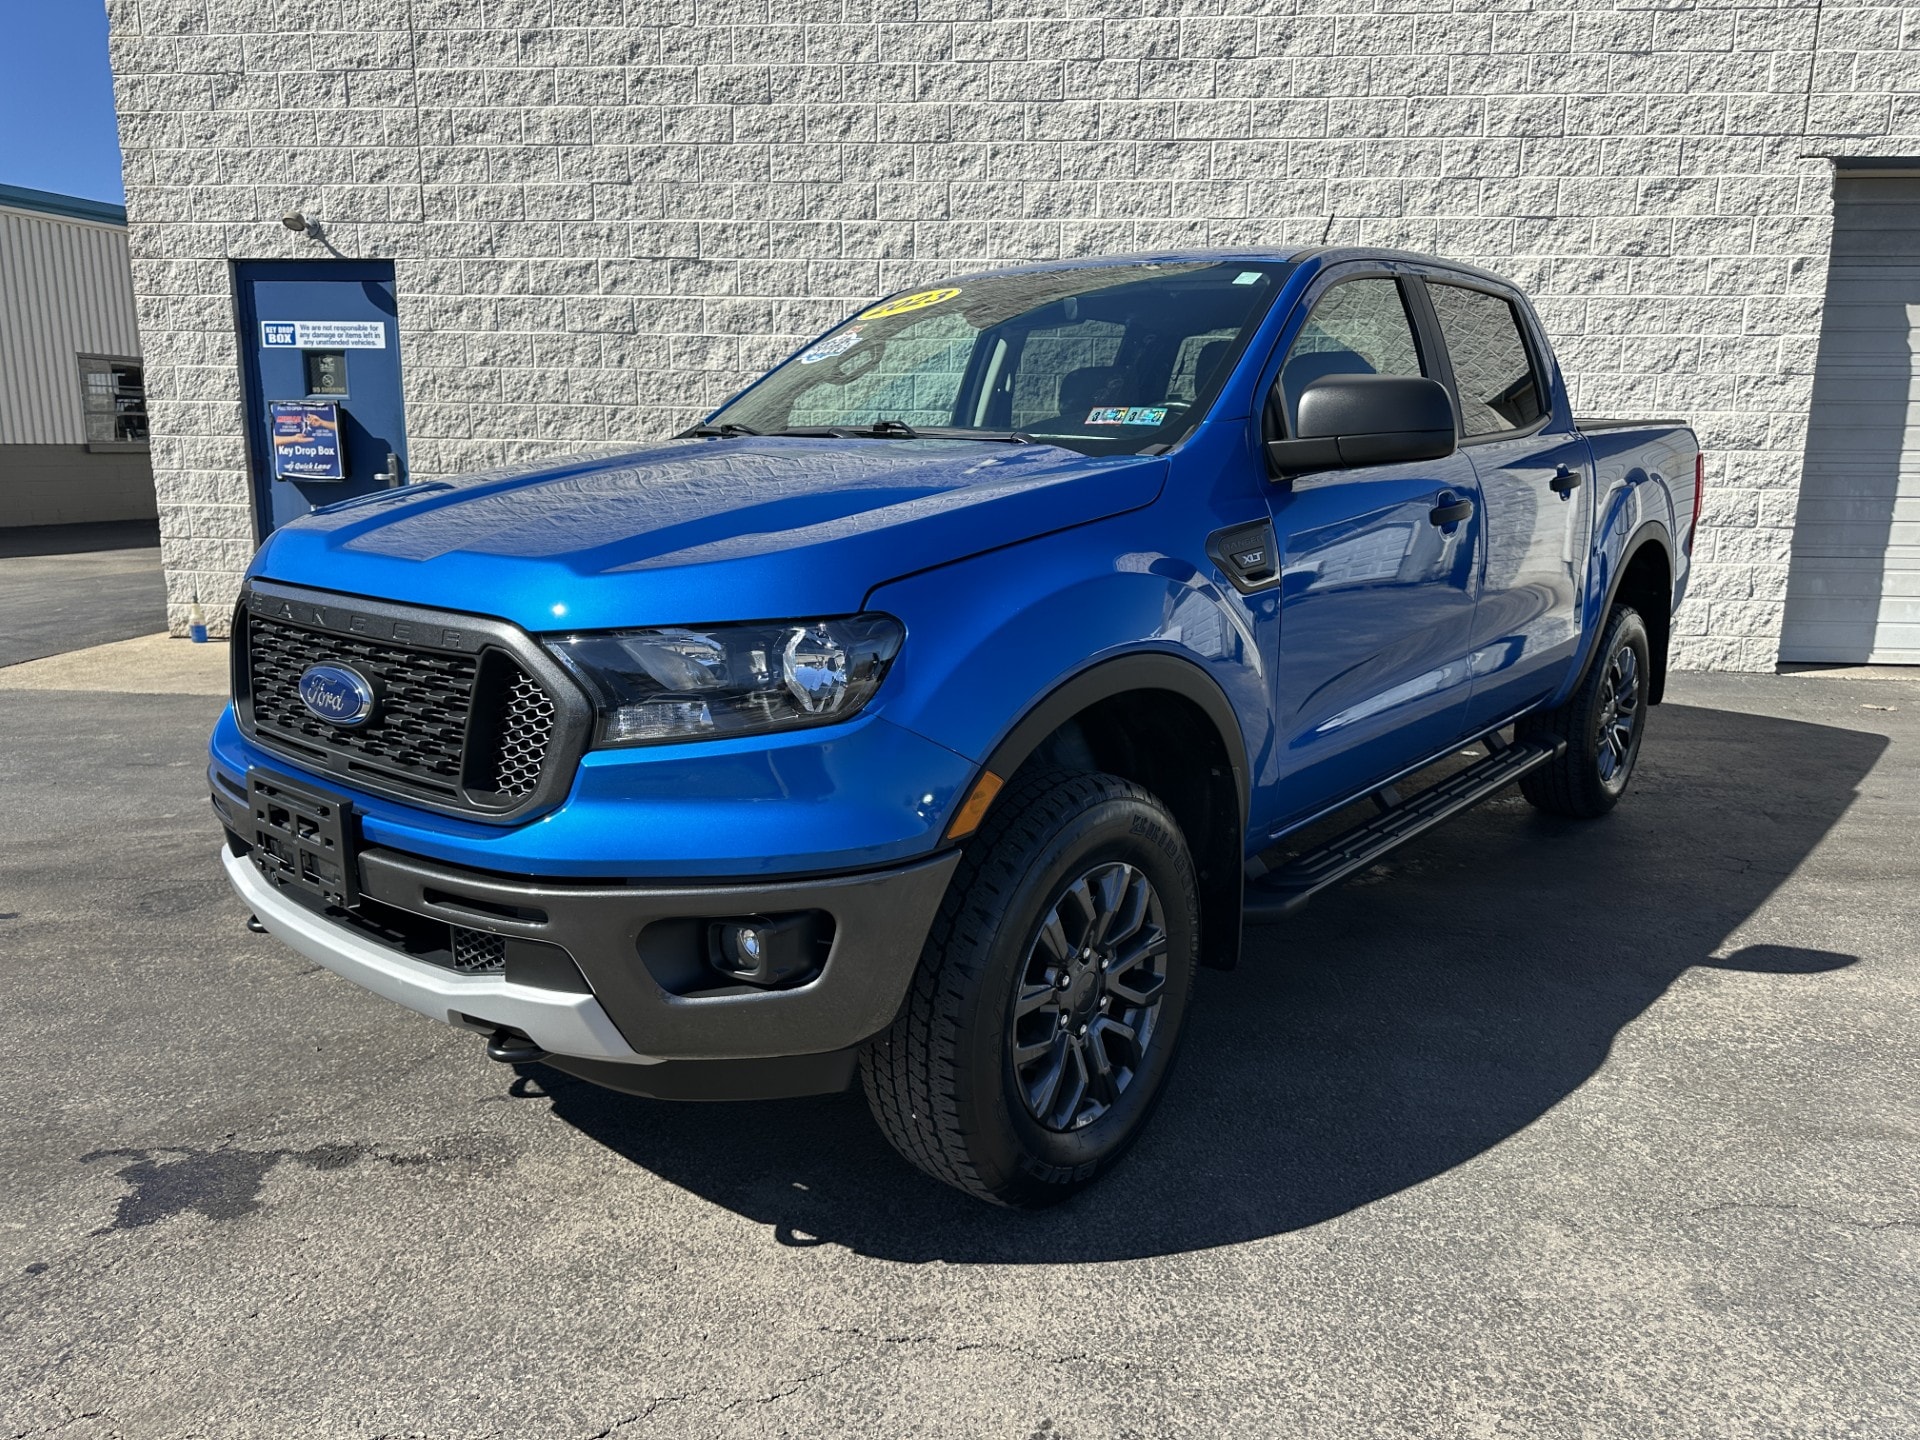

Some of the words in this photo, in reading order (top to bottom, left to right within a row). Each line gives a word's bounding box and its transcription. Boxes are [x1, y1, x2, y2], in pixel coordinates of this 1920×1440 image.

[333, 324, 368, 333] responsible
[268, 333, 293, 344] BOX
[311, 332, 336, 340] damage
[278, 445, 294, 457] Key
[294, 445, 317, 458] Drop
[317, 445, 335, 456] Box
[294, 461, 313, 470] Quick
[1241, 551, 1264, 565] XLT
[250, 590, 462, 649] RANGER
[306, 674, 344, 712] Ford
